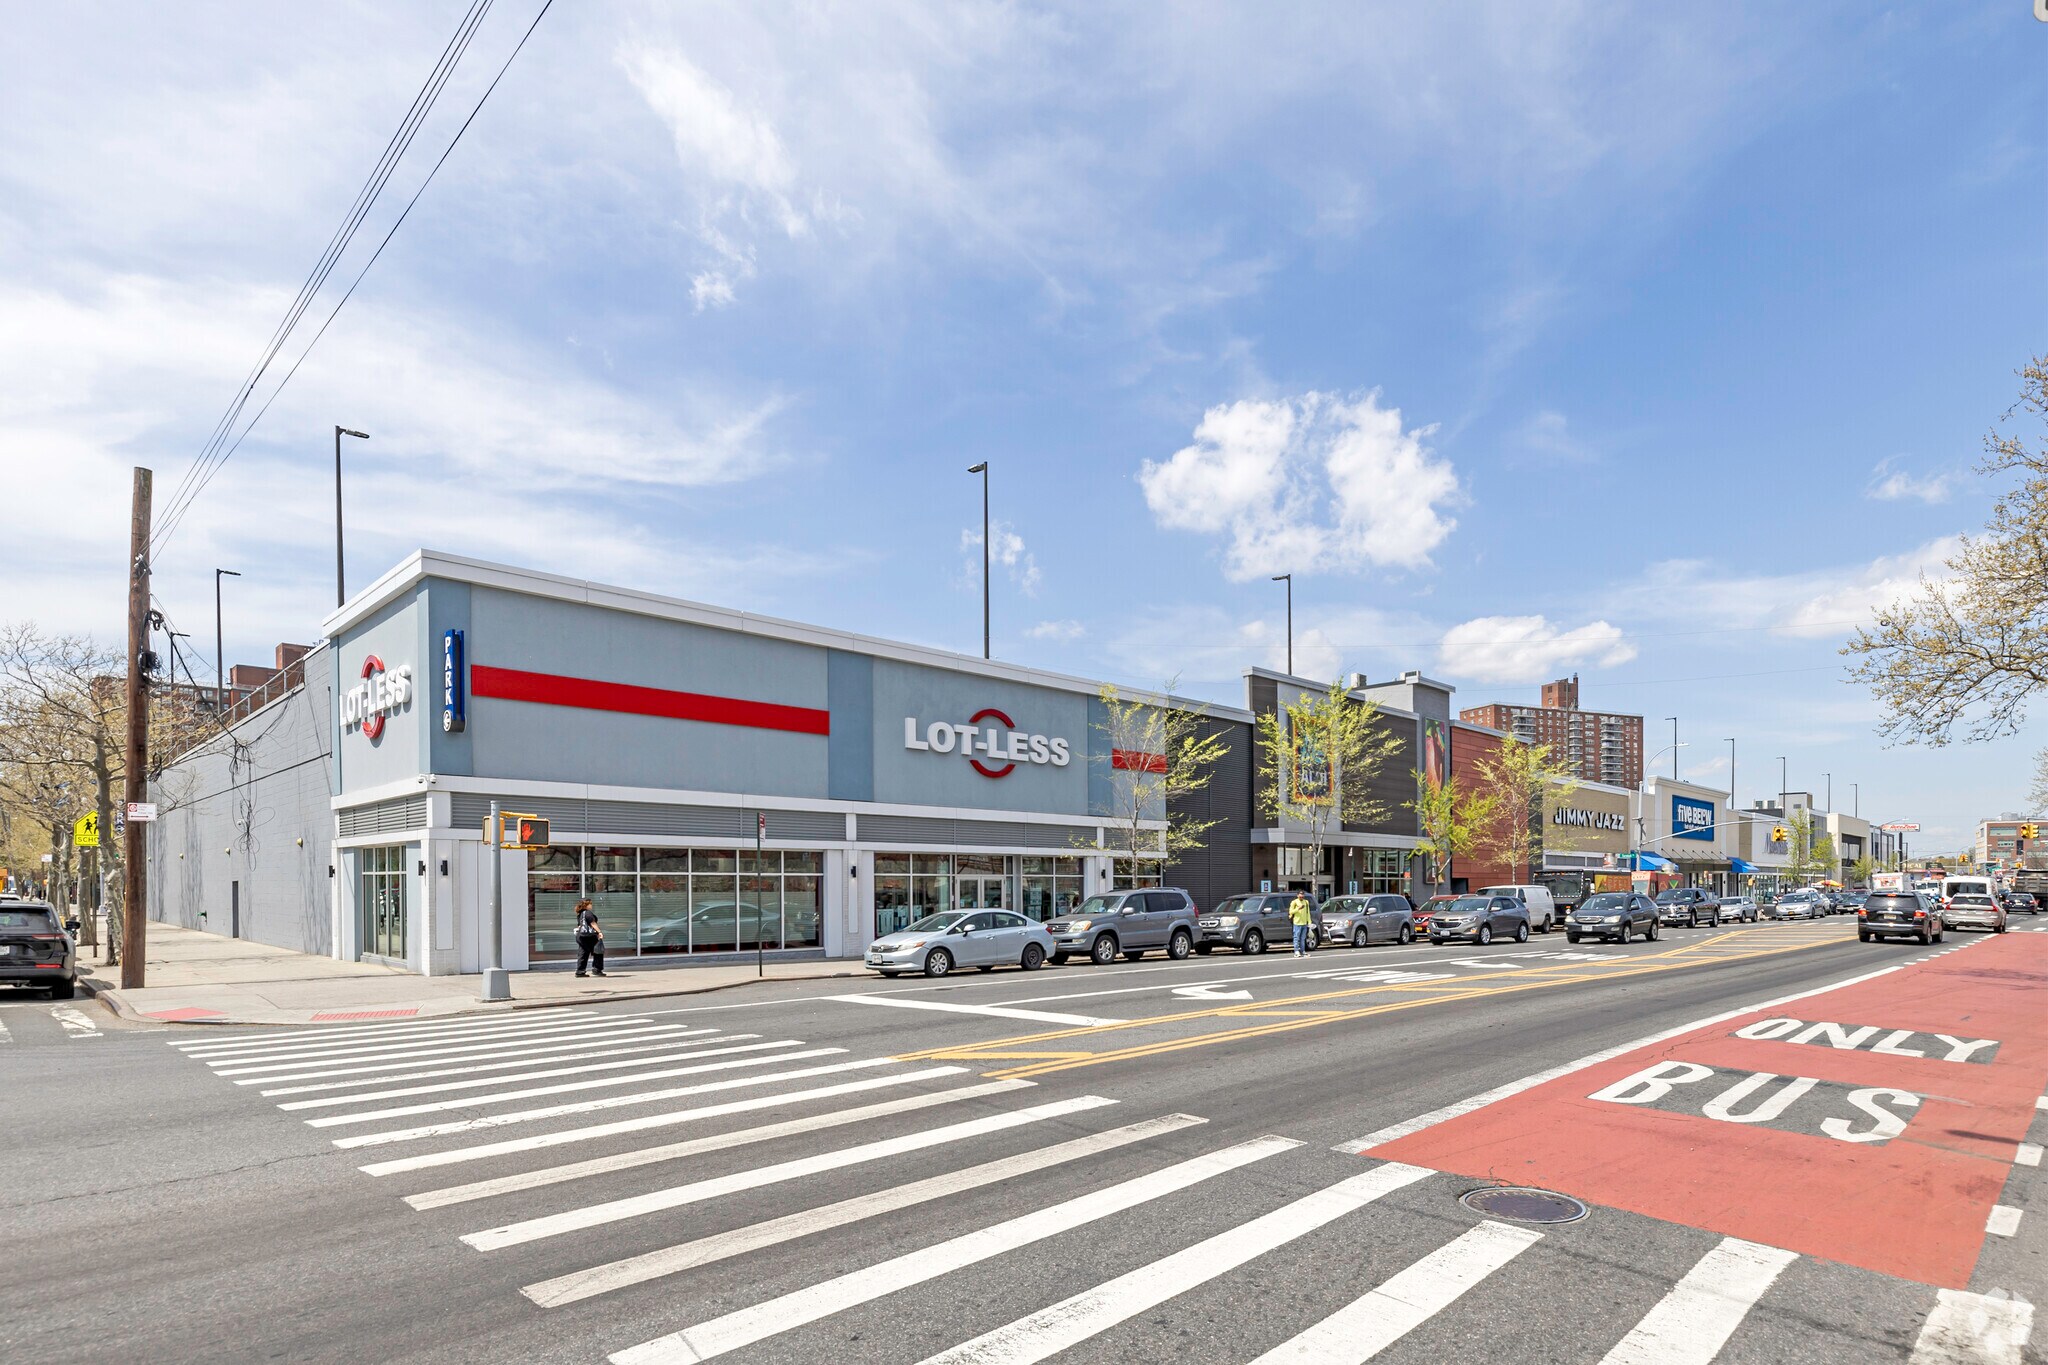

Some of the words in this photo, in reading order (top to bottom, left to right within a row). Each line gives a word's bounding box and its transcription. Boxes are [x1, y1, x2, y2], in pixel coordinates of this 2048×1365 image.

[339, 664, 411, 727] LOT-LESS
[444, 635, 453, 706] PARK
[904, 717, 1070, 766] LOT-LESS
[1554, 807, 1594, 827] JIMMY
[1595, 812, 1625, 831] JAZZ
[1734, 1018, 2000, 1063] ONLY
[1587, 1060, 1920, 1143] BUS
